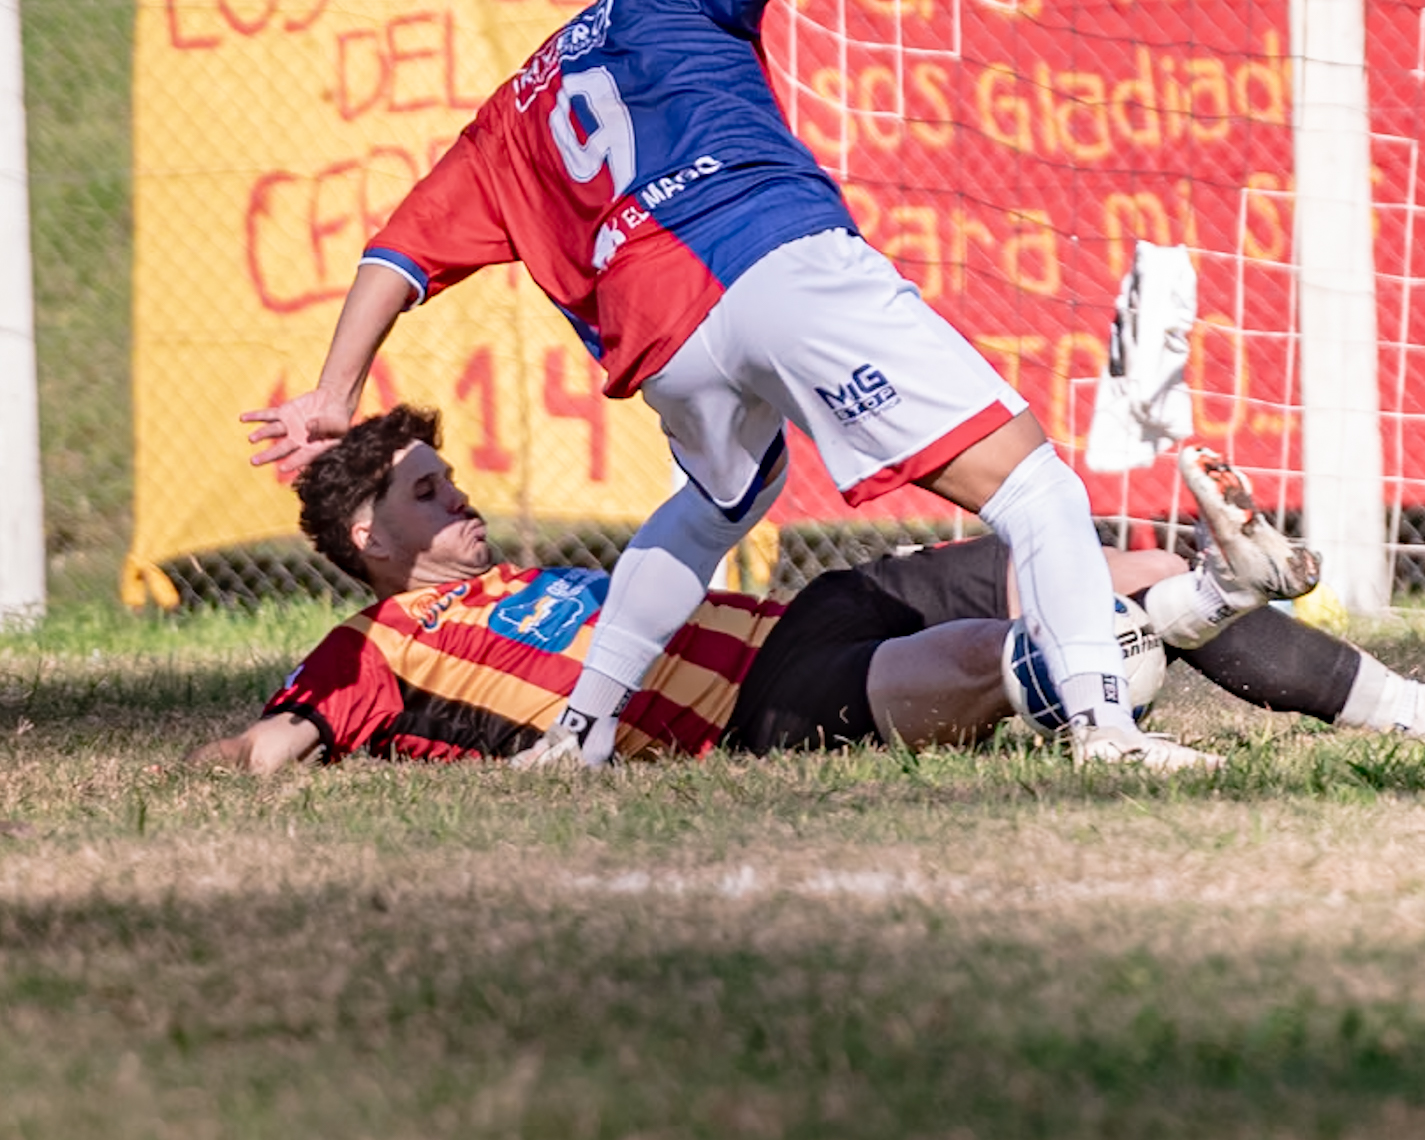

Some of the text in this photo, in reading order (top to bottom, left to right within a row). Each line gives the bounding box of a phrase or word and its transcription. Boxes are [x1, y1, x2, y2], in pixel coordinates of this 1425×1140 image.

[334, 10, 487, 122] DEL
[976, 30, 1297, 162] Gladiad
[549, 64, 637, 203] 9
[621, 205, 651, 229] EL
